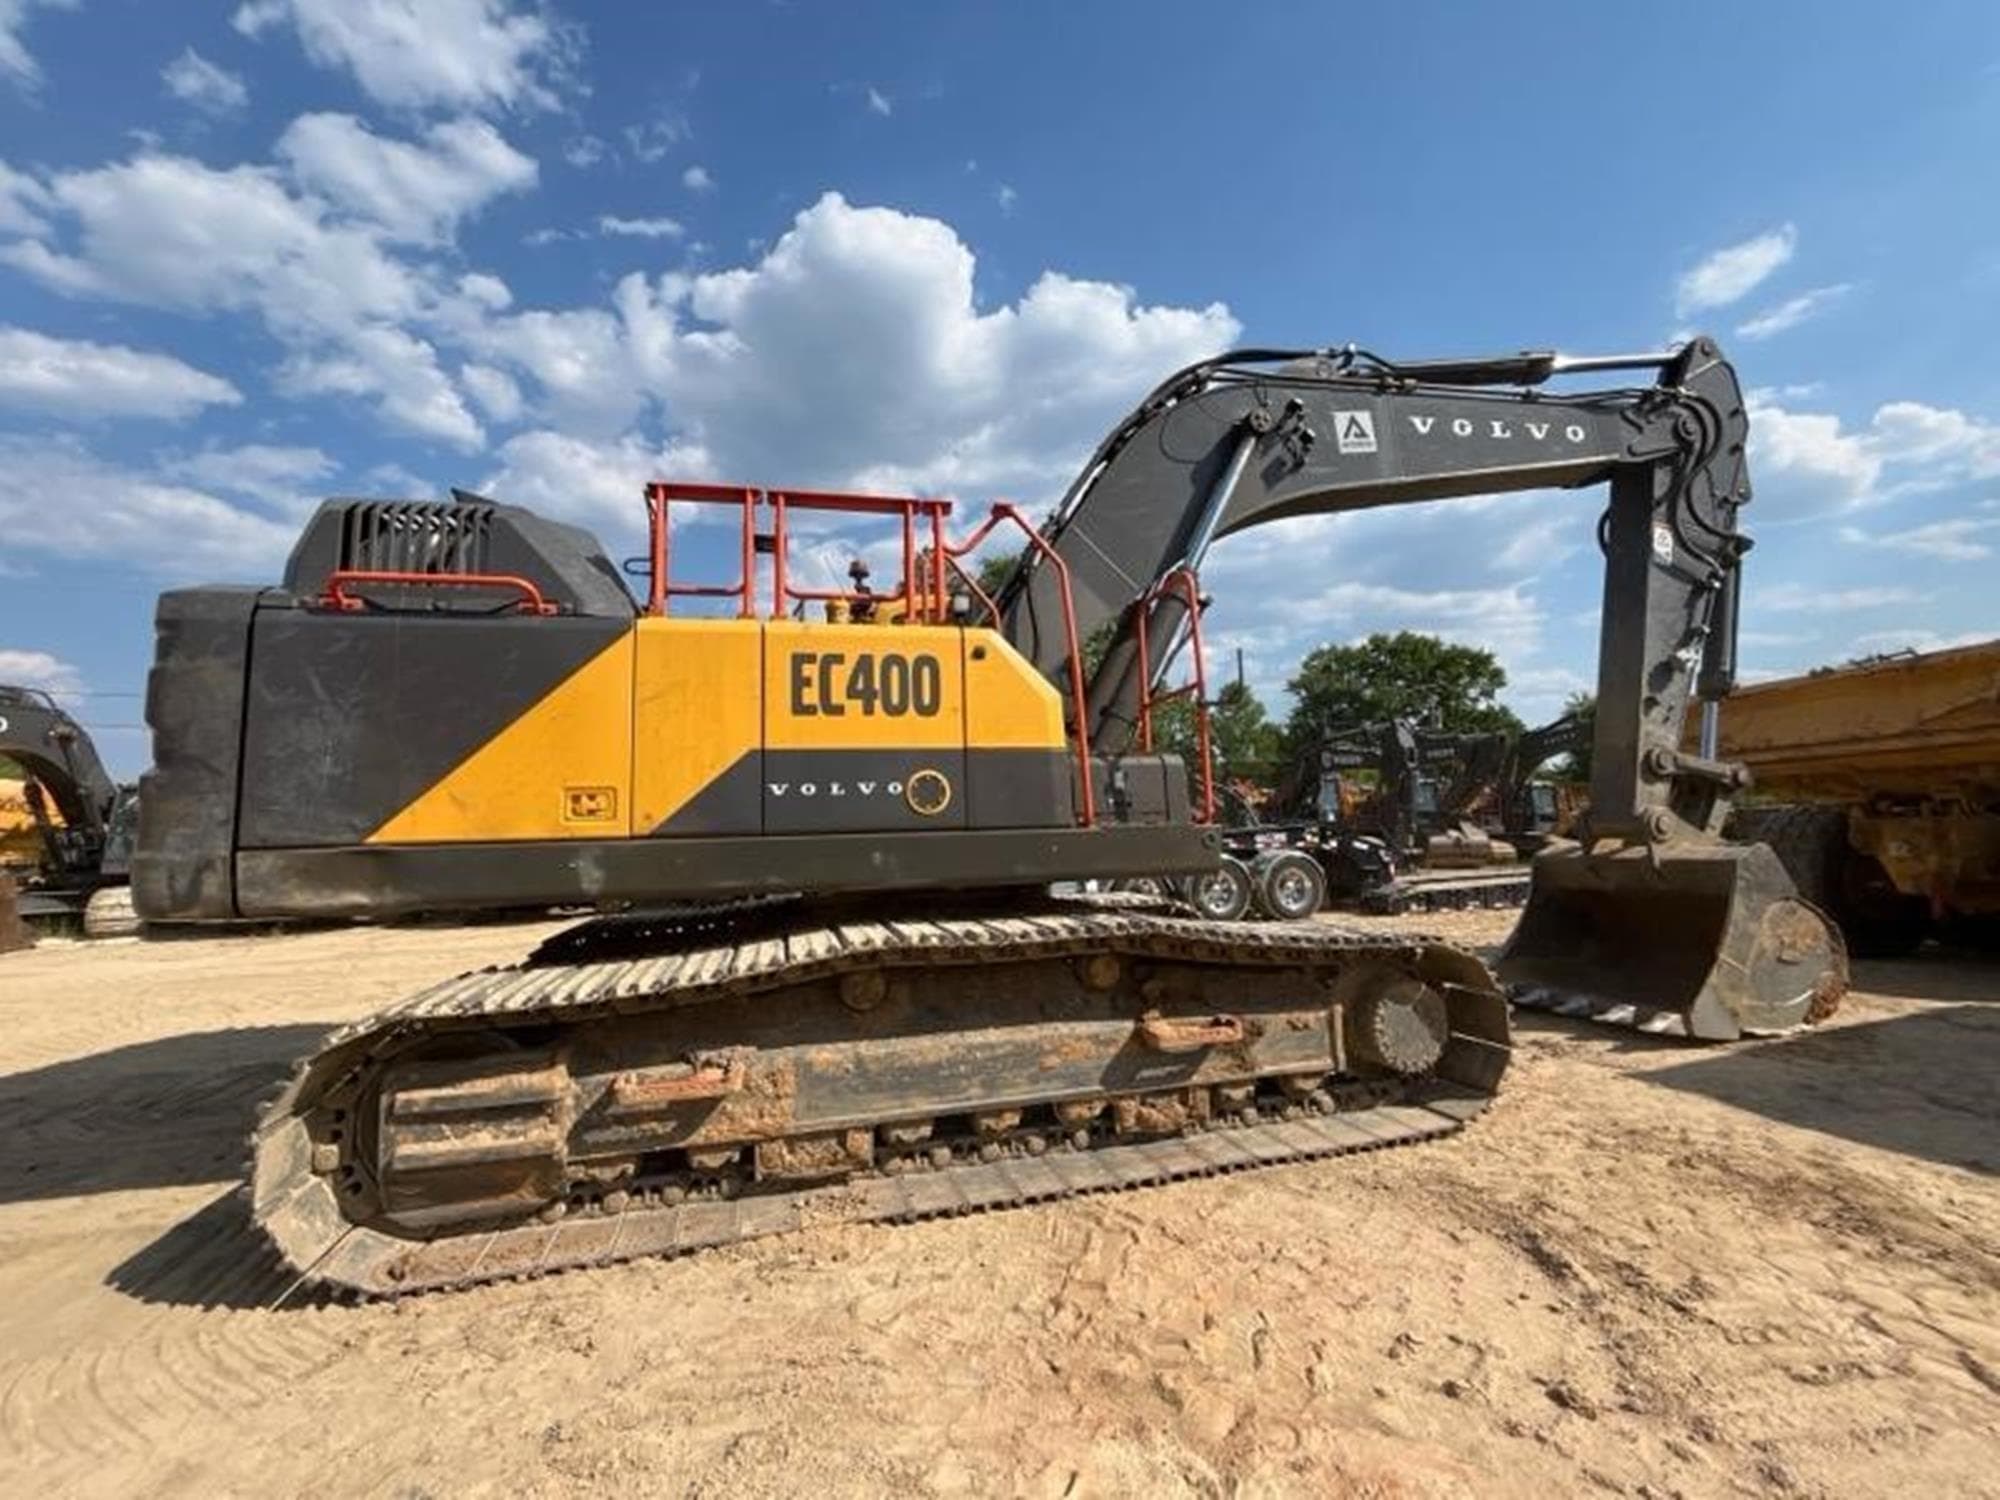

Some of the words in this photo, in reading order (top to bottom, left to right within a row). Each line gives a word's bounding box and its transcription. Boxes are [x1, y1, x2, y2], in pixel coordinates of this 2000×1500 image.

[1408, 415, 1586, 442] VOLVO
[790, 652, 941, 717] EC400
[768, 781, 904, 796] VOLVO
